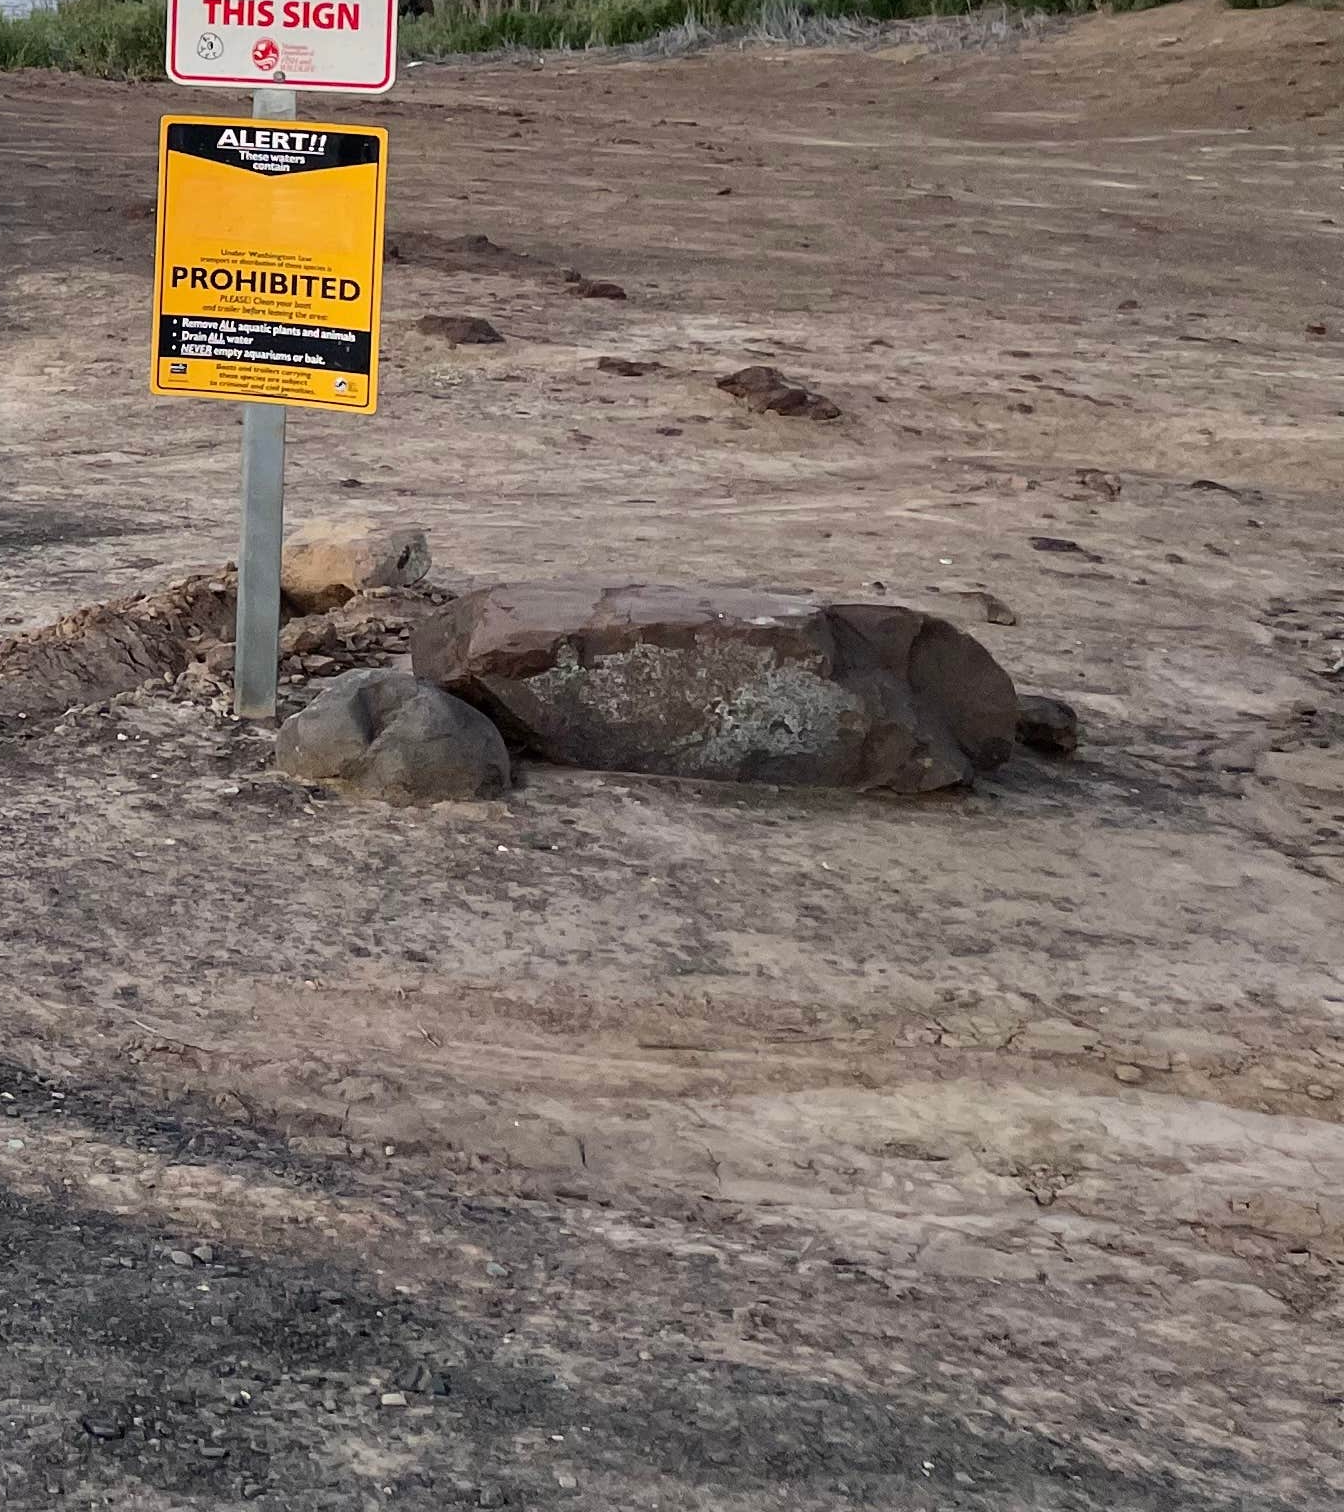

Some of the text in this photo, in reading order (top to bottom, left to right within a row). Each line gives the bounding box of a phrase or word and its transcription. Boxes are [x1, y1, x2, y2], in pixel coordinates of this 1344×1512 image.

[282, 1, 361, 30] SIGN
[217, 128, 328, 152] ALERT!!
[238, 150, 306, 164] These waters
[252, 162, 290, 172] contain
[171, 266, 361, 302] PROHIBITED
[181, 330, 254, 345] Drain ALL water
[182, 318, 356, 342] Remove ALL aquatic plants and animals
[181, 344, 326, 365] NEVER empty aquariums or bait.
